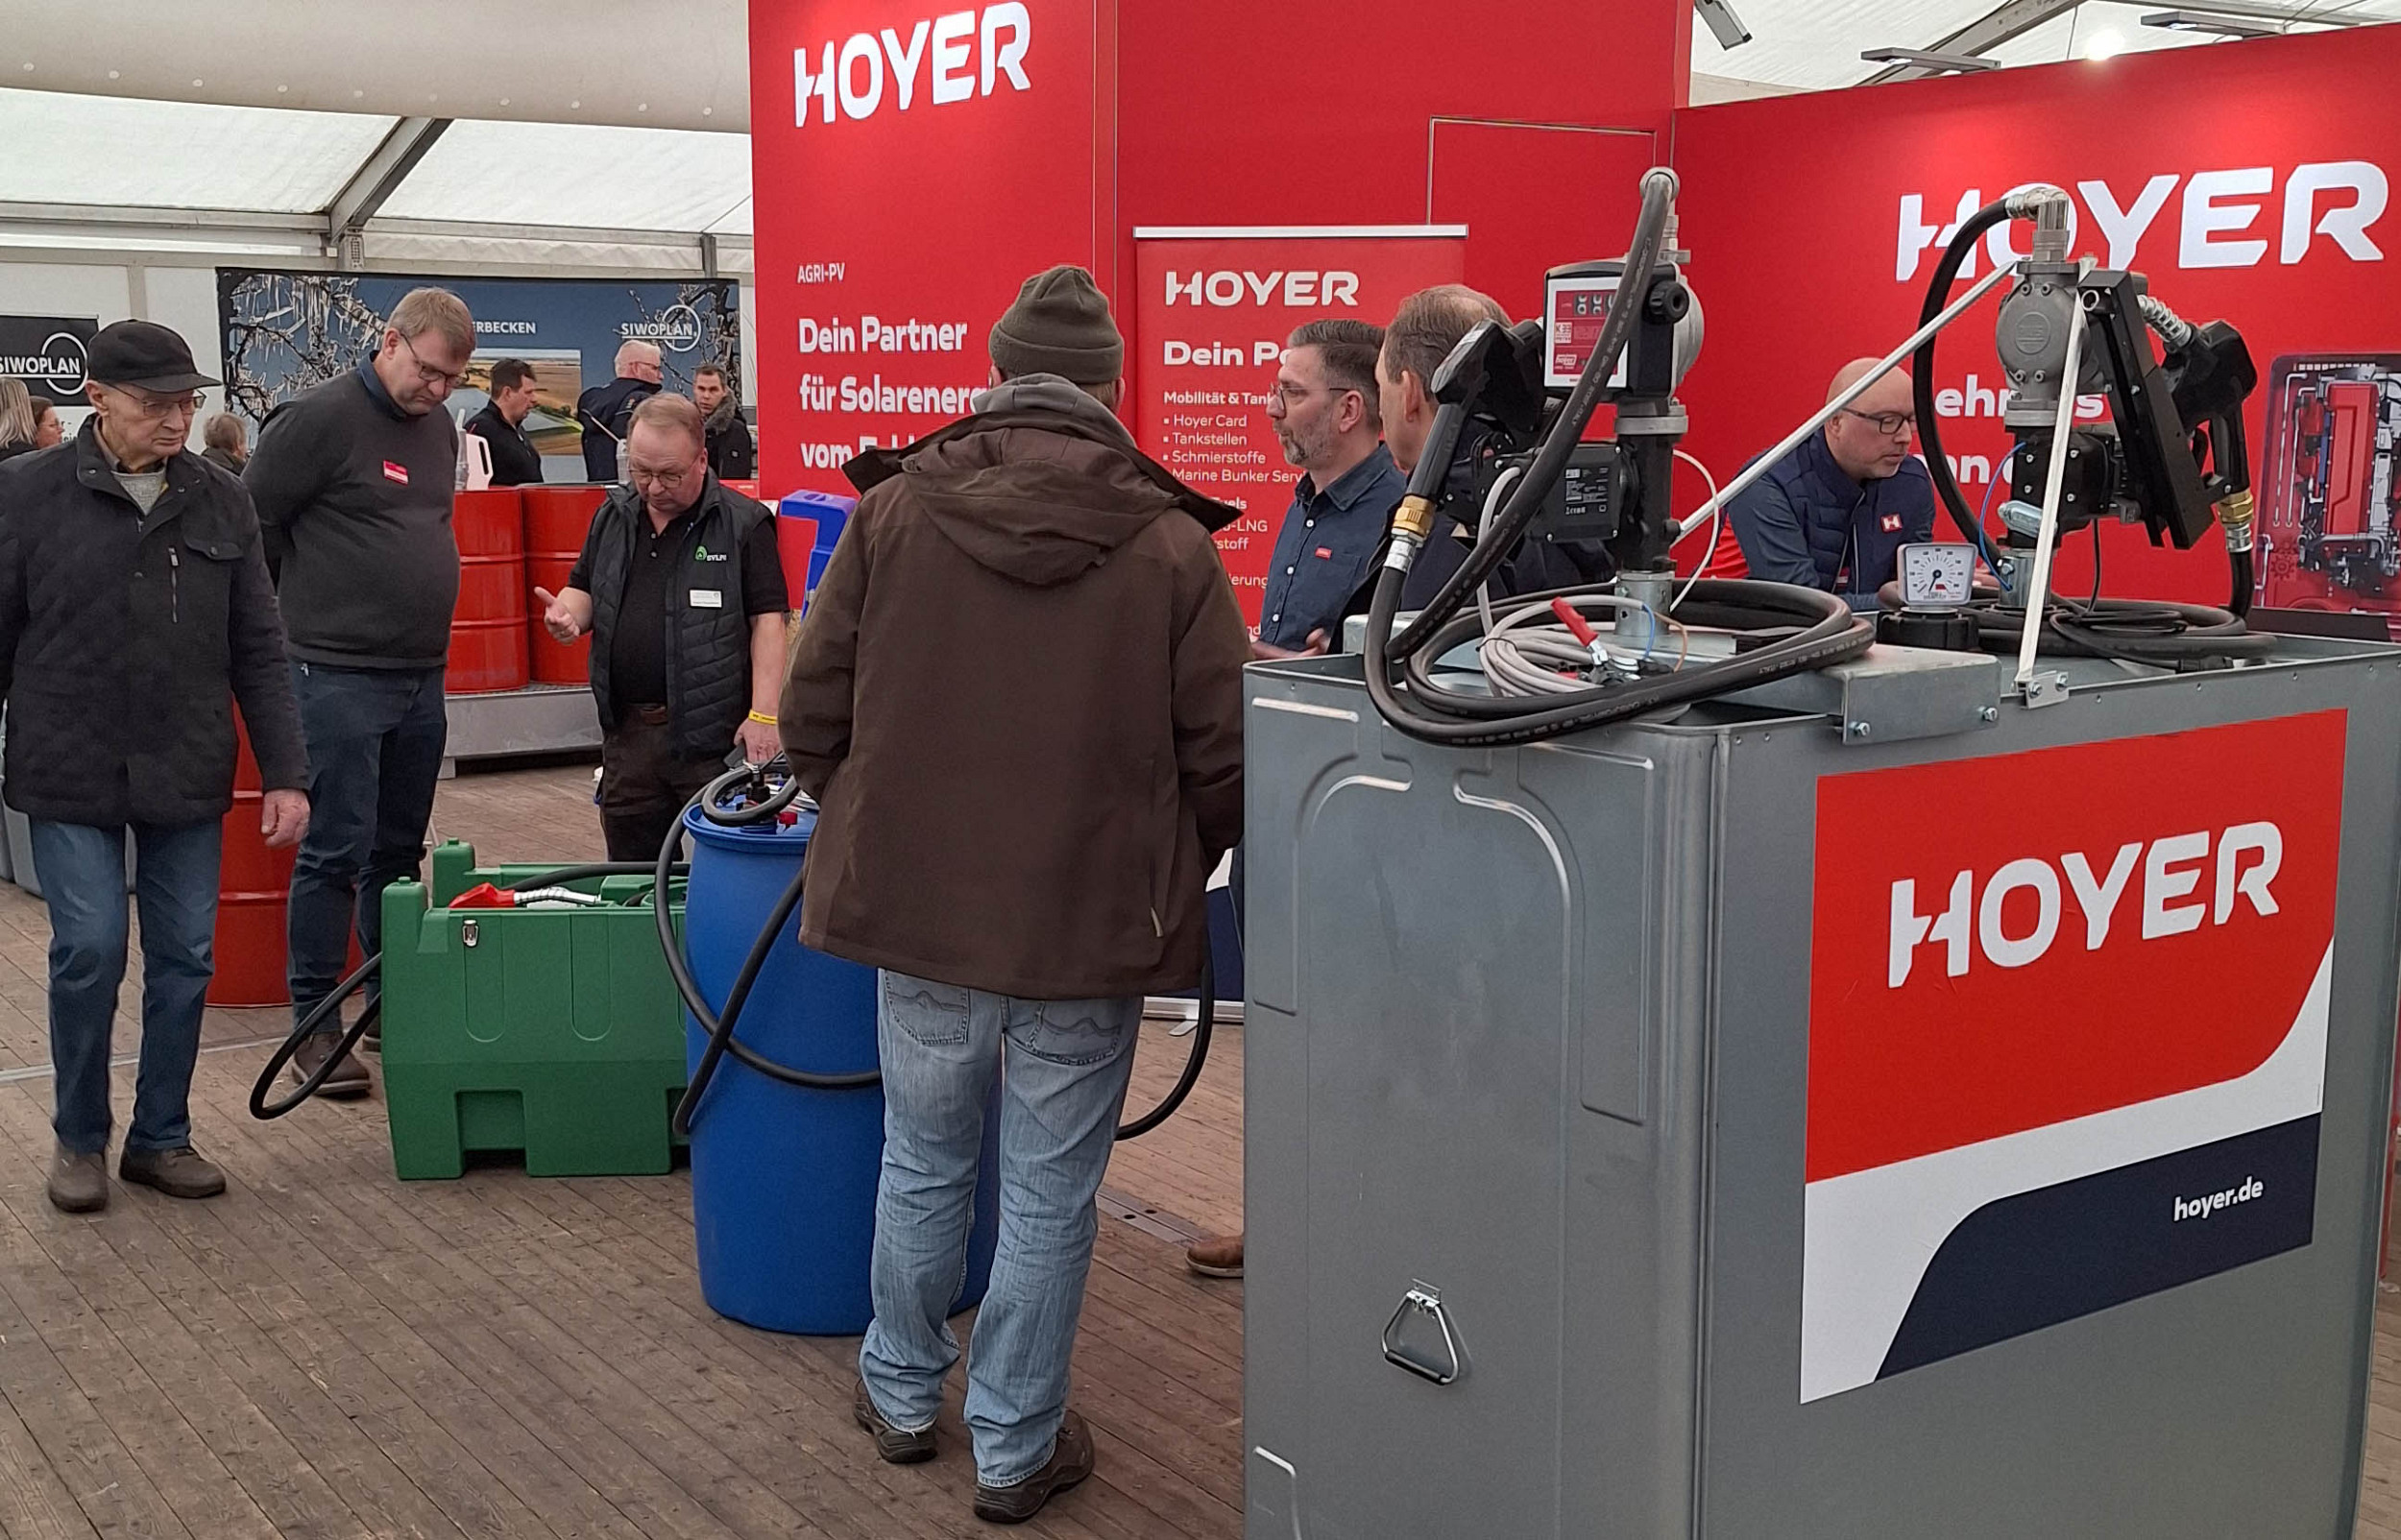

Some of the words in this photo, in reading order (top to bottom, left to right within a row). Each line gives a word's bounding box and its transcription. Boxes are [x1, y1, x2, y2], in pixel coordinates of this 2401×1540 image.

[793, 1, 1031, 128] HOYER
[1896, 160, 2389, 282] HOYER
[797, 262, 845, 283] AGRI-PV
[1165, 270, 1359, 307] HOYER
[621, 323, 692, 335] SIWOPLAN
[799, 317, 856, 353] Dein
[861, 316, 967, 352] Partner
[1164, 340, 1244, 366] Dein
[800, 373, 837, 411] für
[1163, 391, 1225, 404] Mobilität
[1228, 393, 1239, 404] &
[1174, 414, 1213, 429] Hoyer
[1216, 415, 1248, 427] Card
[1173, 432, 1248, 445] Tankstellen
[801, 442, 853, 469] vom
[1172, 450, 1266, 464] Schmierstoffe
[1173, 469, 1218, 481] Marine
[1222, 469, 1270, 482] Bunker
[1228, 573, 1268, 590] erung
[1888, 821, 2284, 989] HOYER
[2173, 1175, 2265, 1222] hoyer.de
